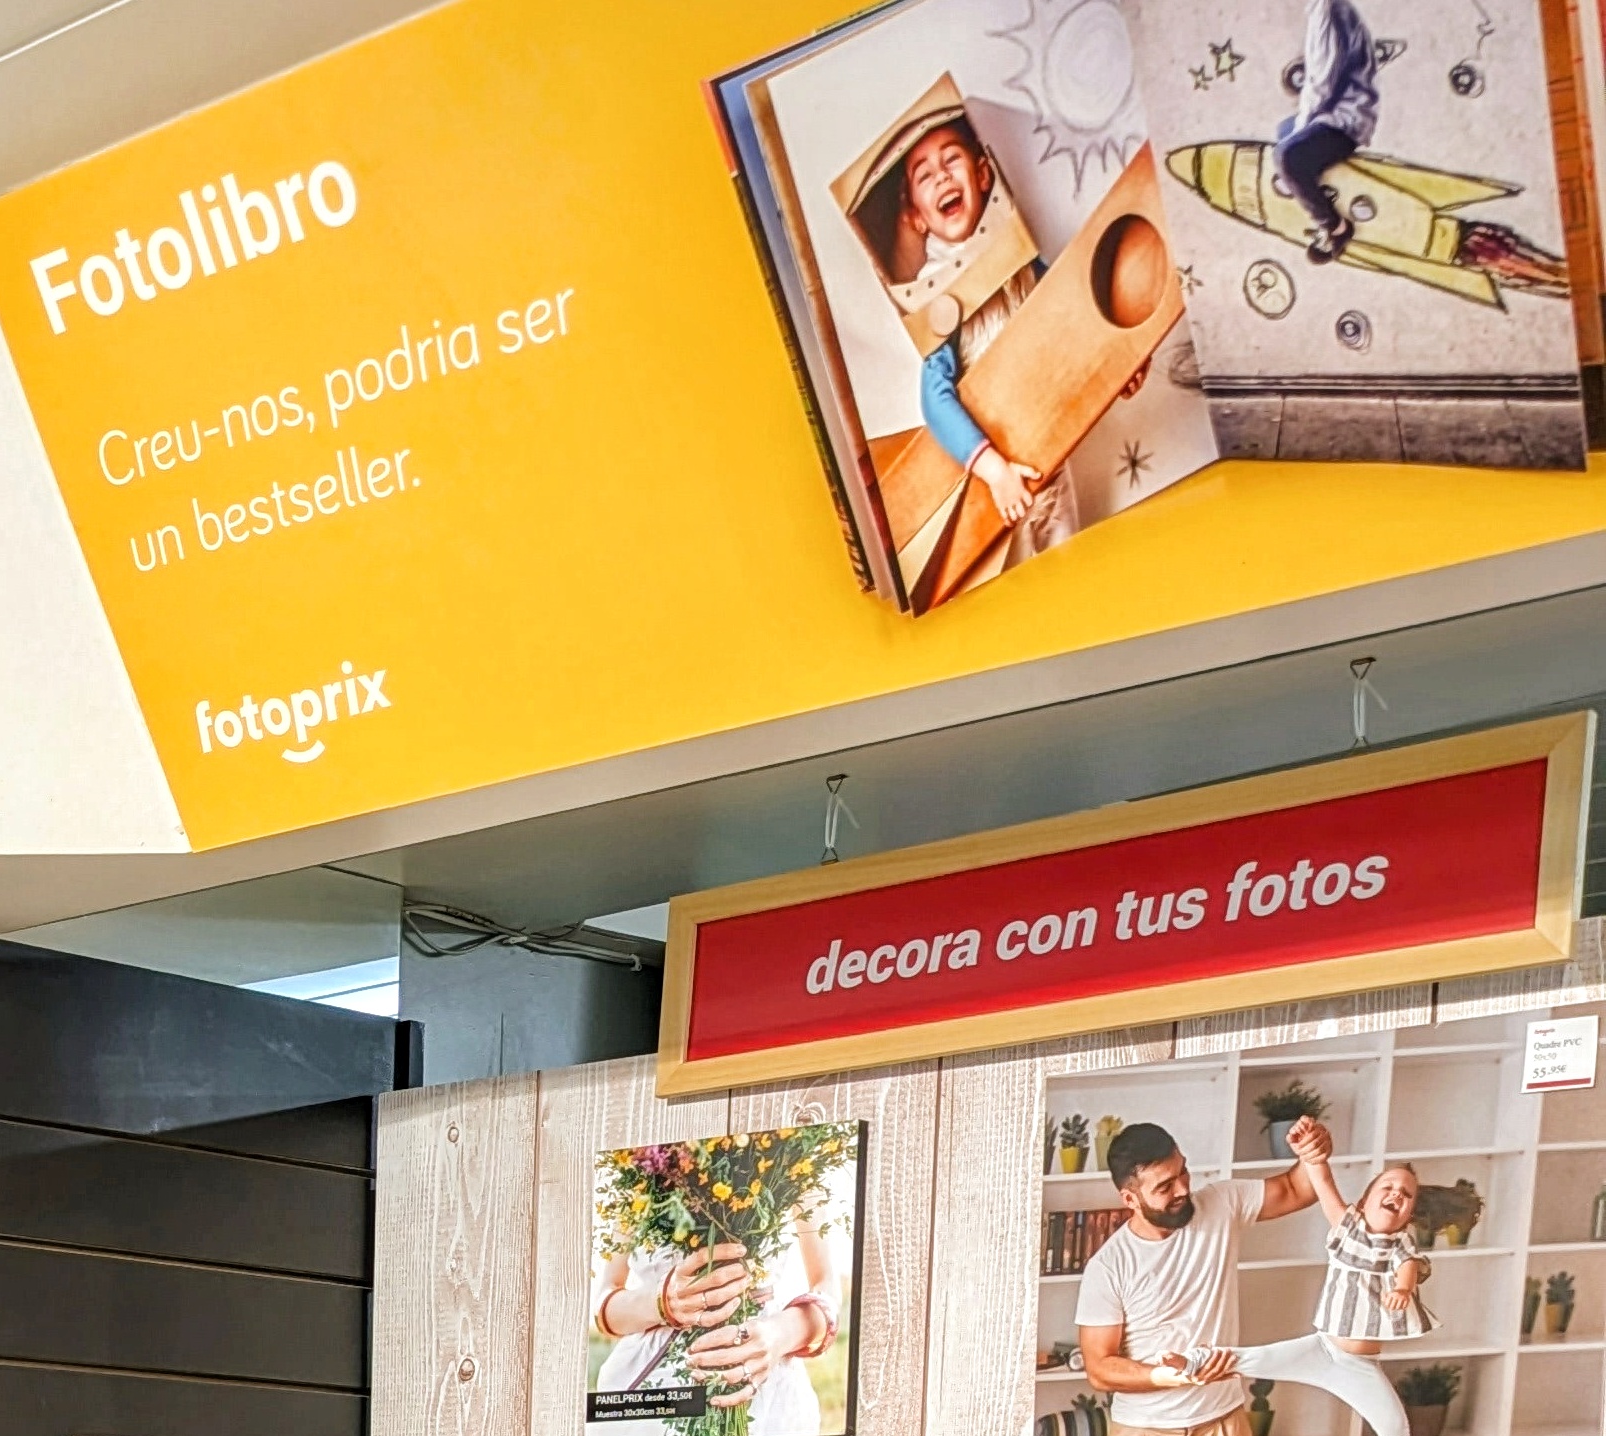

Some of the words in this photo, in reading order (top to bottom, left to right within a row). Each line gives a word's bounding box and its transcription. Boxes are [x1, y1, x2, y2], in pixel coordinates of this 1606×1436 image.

[30, 160, 358, 334] Fotolibro
[97, 385, 315, 486] Creu-nos,
[325, 324, 481, 428] podria
[498, 286, 575, 354] ser
[130, 527, 185, 572] un
[196, 445, 422, 552] bestseller.
[195, 661, 392, 755] fotoprix
[804, 927, 981, 995] decora
[995, 908, 1098, 962] con
[1115, 886, 1209, 944] tus
[1224, 852, 1390, 926] fotos
[1563, 1038, 1582, 1047] PVC
[595, 1393, 643, 1405] PANELPRIX
